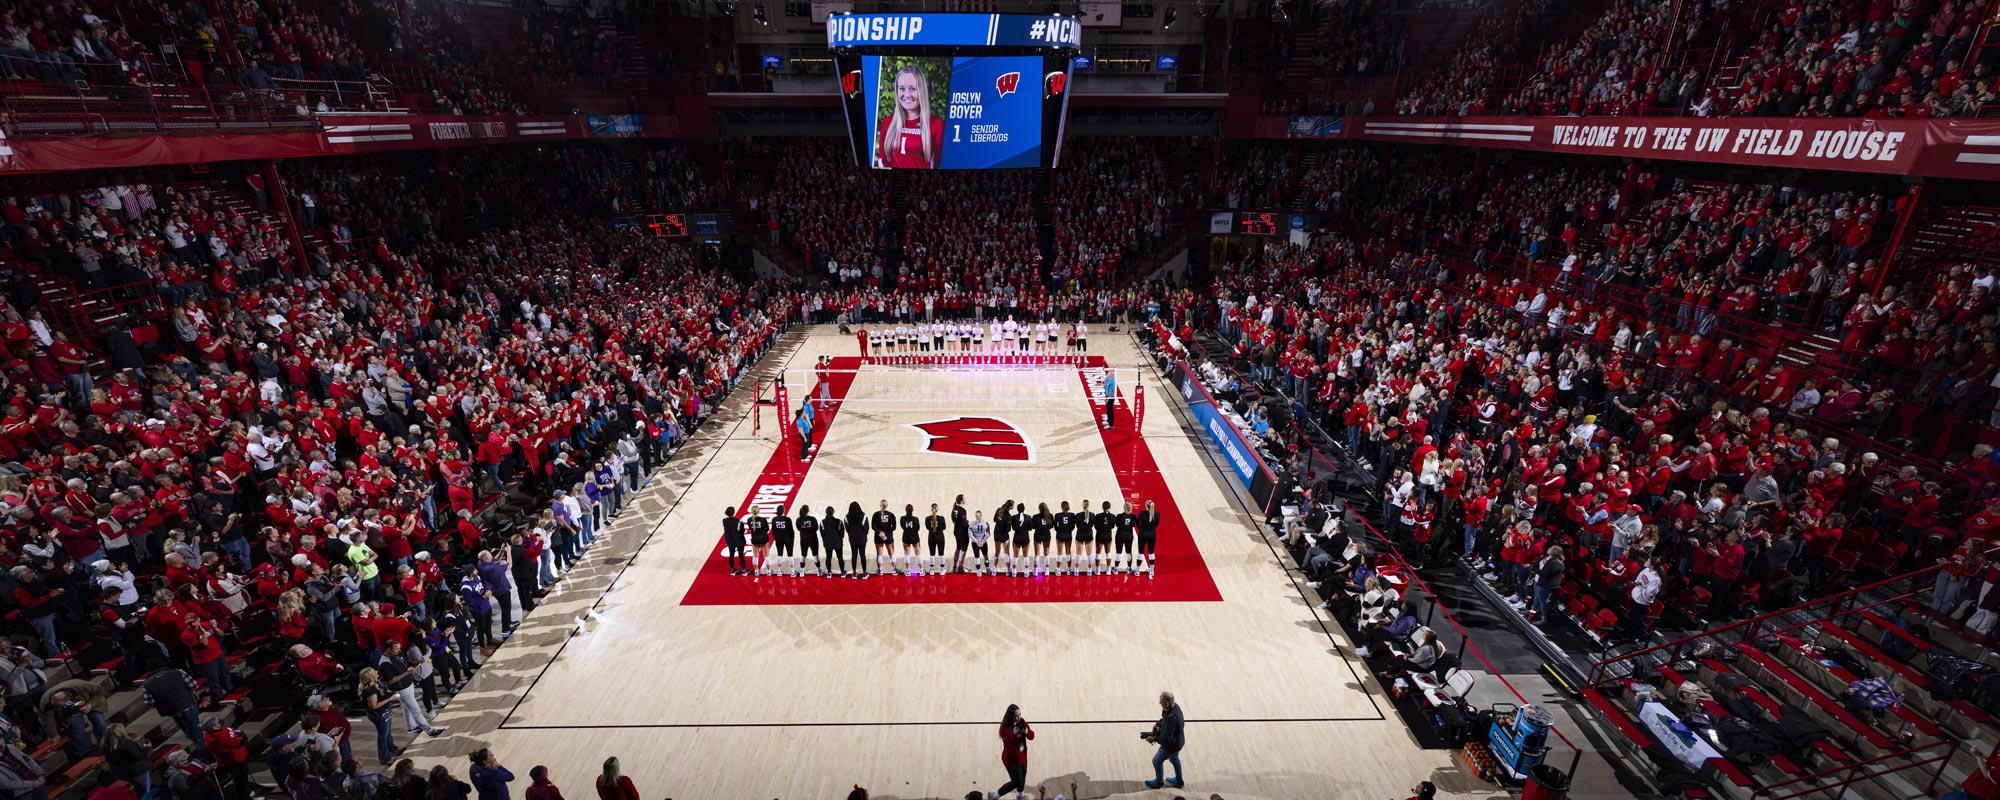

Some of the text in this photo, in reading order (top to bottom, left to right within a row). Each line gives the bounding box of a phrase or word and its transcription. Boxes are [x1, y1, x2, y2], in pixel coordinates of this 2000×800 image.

[951, 92, 981, 104] JOSLYN
[949, 105, 983, 119] BOYER
[428, 122, 471, 140] FOREVER
[952, 125, 961, 143] 1
[971, 124, 999, 133] SENIOR
[970, 133, 1009, 143] LIBERO/DS
[1552, 125, 1906, 161] WELCOME TO THE UW FIELD HOUSE
[780, 397, 788, 438] WISCONSIN
[775, 521, 786, 529] 25
[905, 521, 913, 529] 14
[1063, 516, 1069, 524] 5
[1124, 518, 1131, 526] 2
